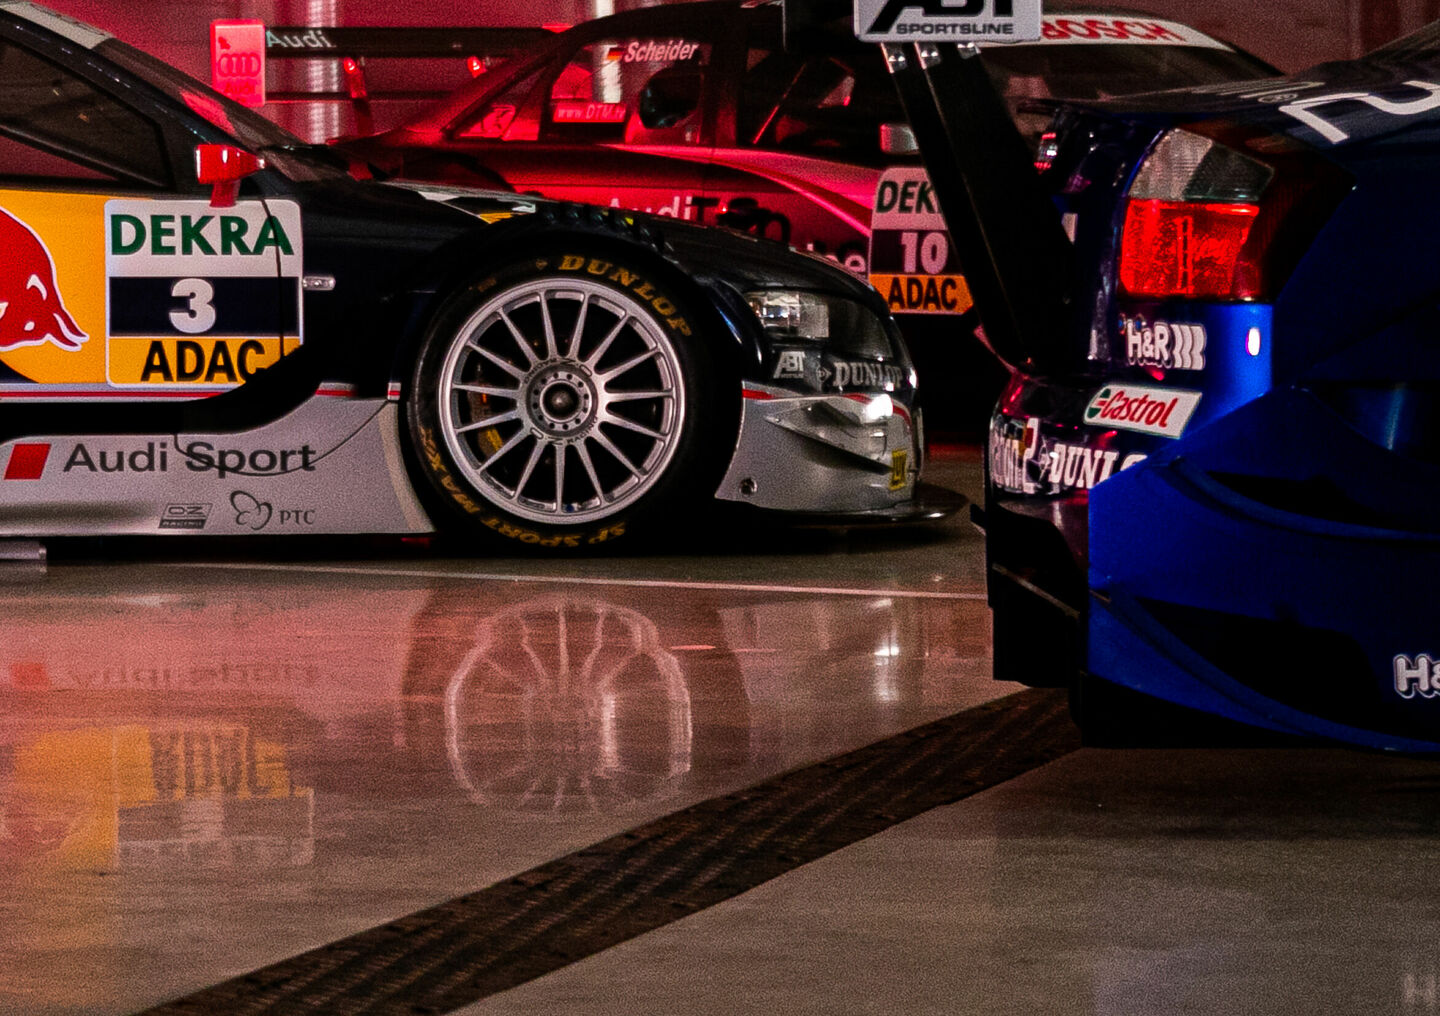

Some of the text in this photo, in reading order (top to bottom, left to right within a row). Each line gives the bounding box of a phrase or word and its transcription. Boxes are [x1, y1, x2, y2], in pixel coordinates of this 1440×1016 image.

[266, 30, 333, 48] Audi
[896, 23, 1014, 35] SPORTSLINE
[624, 40, 700, 63] Scheider
[876, 180, 942, 214] DEK
[111, 214, 294, 256] DEKRA
[900, 232, 948, 274] 10
[169, 278, 217, 333] 3
[558, 254, 692, 336] DUNLOP
[887, 277, 959, 312] ADAC
[140, 340, 265, 382] ADAC
[1126, 322, 1172, 368] H&R
[773, 351, 806, 379] ABT
[1101, 389, 1180, 428] Castrol
[62, 440, 317, 478] Audi Sport
[1048, 443, 1148, 489] DUNL
[278, 509, 316, 525] PTC
[480, 516, 583, 548] SPORT
[587, 521, 626, 546] SP
